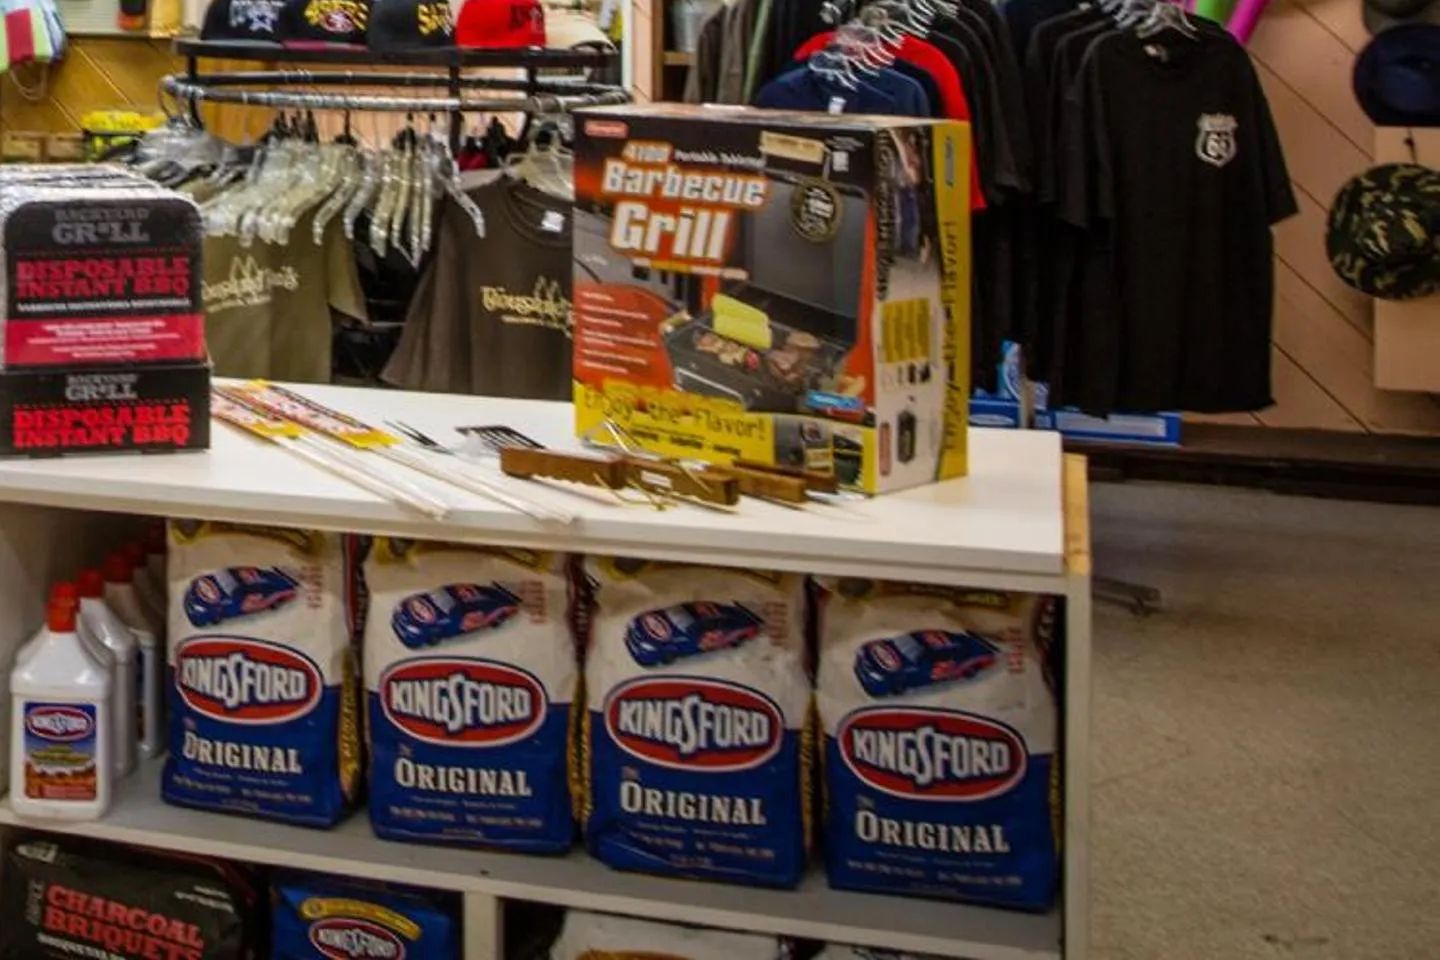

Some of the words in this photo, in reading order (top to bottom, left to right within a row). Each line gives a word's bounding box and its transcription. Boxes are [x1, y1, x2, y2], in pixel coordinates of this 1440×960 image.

[603, 158, 767, 206] Barbecue
[611, 201, 730, 260] Grill
[17, 256, 191, 280] DISPOSABLE
[17, 279, 127, 298] INSTANT
[134, 274, 191, 298] BBQ
[13, 405, 190, 429] DISPOSABLE
[13, 427, 127, 448] INSTANT
[133, 423, 190, 447] BBQ
[181, 652, 308, 709] KINGSFORD
[389, 673, 532, 733] KINGSFORD
[618, 694, 771, 755] KINGSFORD
[182, 730, 304, 774] ORIGINAL
[852, 726, 1011, 786] KINGSFORD
[394, 758, 533, 798] ORIGINAL
[619, 781, 768, 826] ORIGINAL
[855, 810, 1011, 853] ORIGINAL
[46, 884, 204, 949] CHARCOAL
